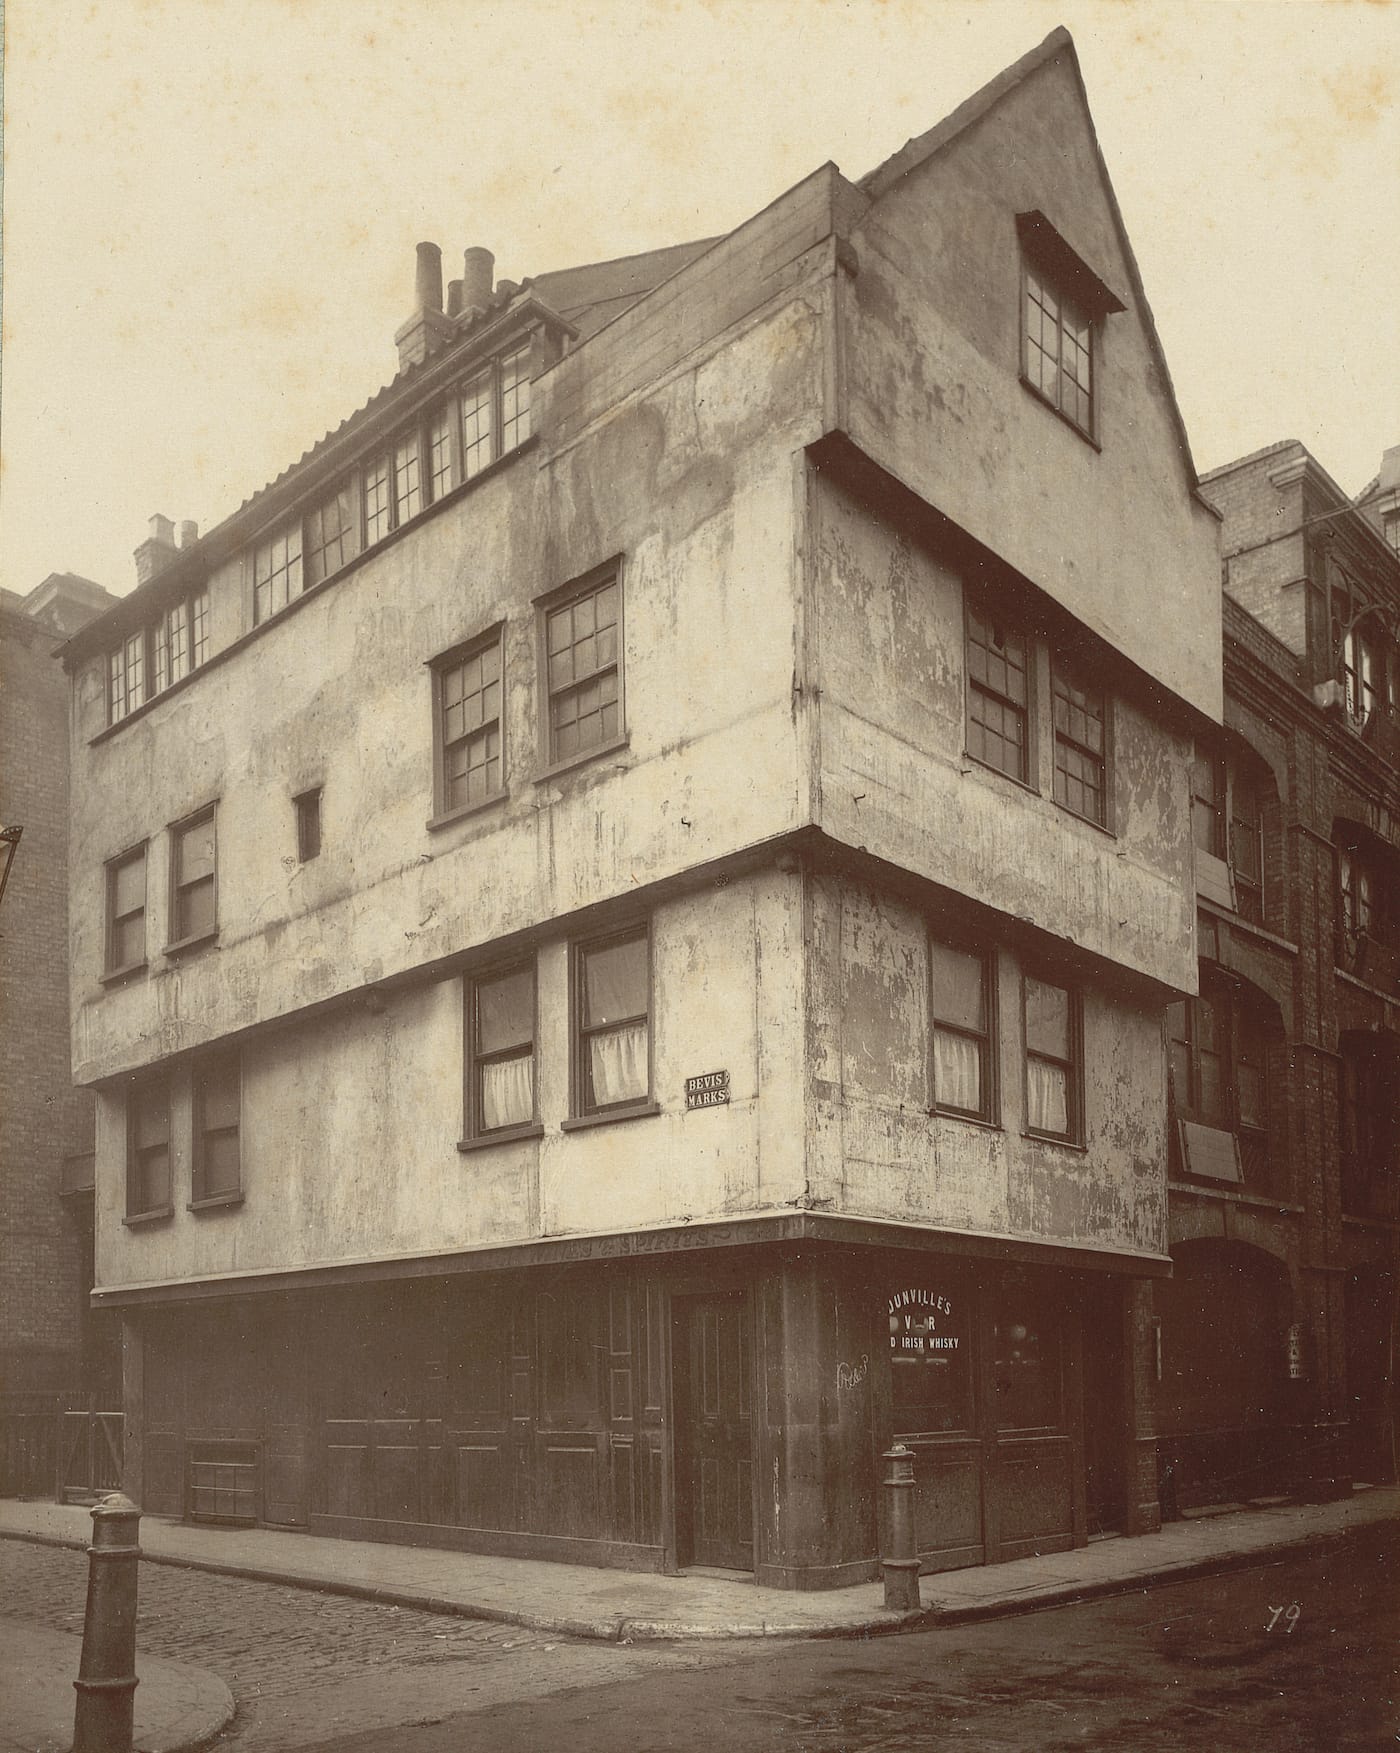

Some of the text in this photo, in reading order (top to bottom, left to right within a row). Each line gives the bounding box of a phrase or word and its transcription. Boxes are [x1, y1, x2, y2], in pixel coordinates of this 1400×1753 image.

[689, 1074, 722, 1091] BEVIS
[688, 1090, 726, 1106] MARKS
[902, 1336, 923, 1348] IRISH
[929, 1337, 959, 1348] WHISKY
